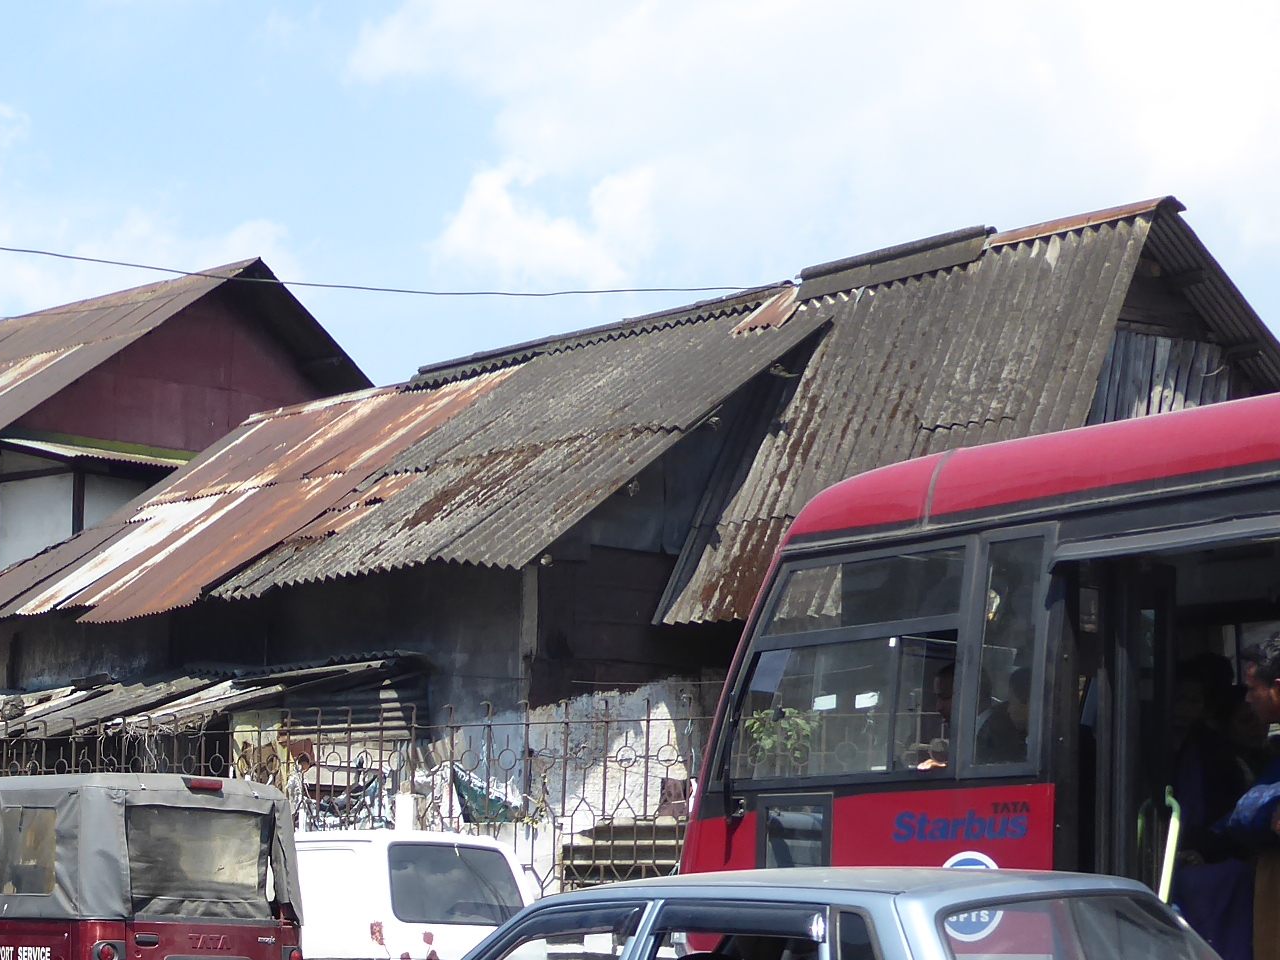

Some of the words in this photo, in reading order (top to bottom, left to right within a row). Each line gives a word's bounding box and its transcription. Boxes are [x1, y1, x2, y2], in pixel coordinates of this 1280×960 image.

[990, 801, 1031, 814] TATA
[892, 809, 1029, 844] Starbus
[188, 933, 232, 950] TATA
